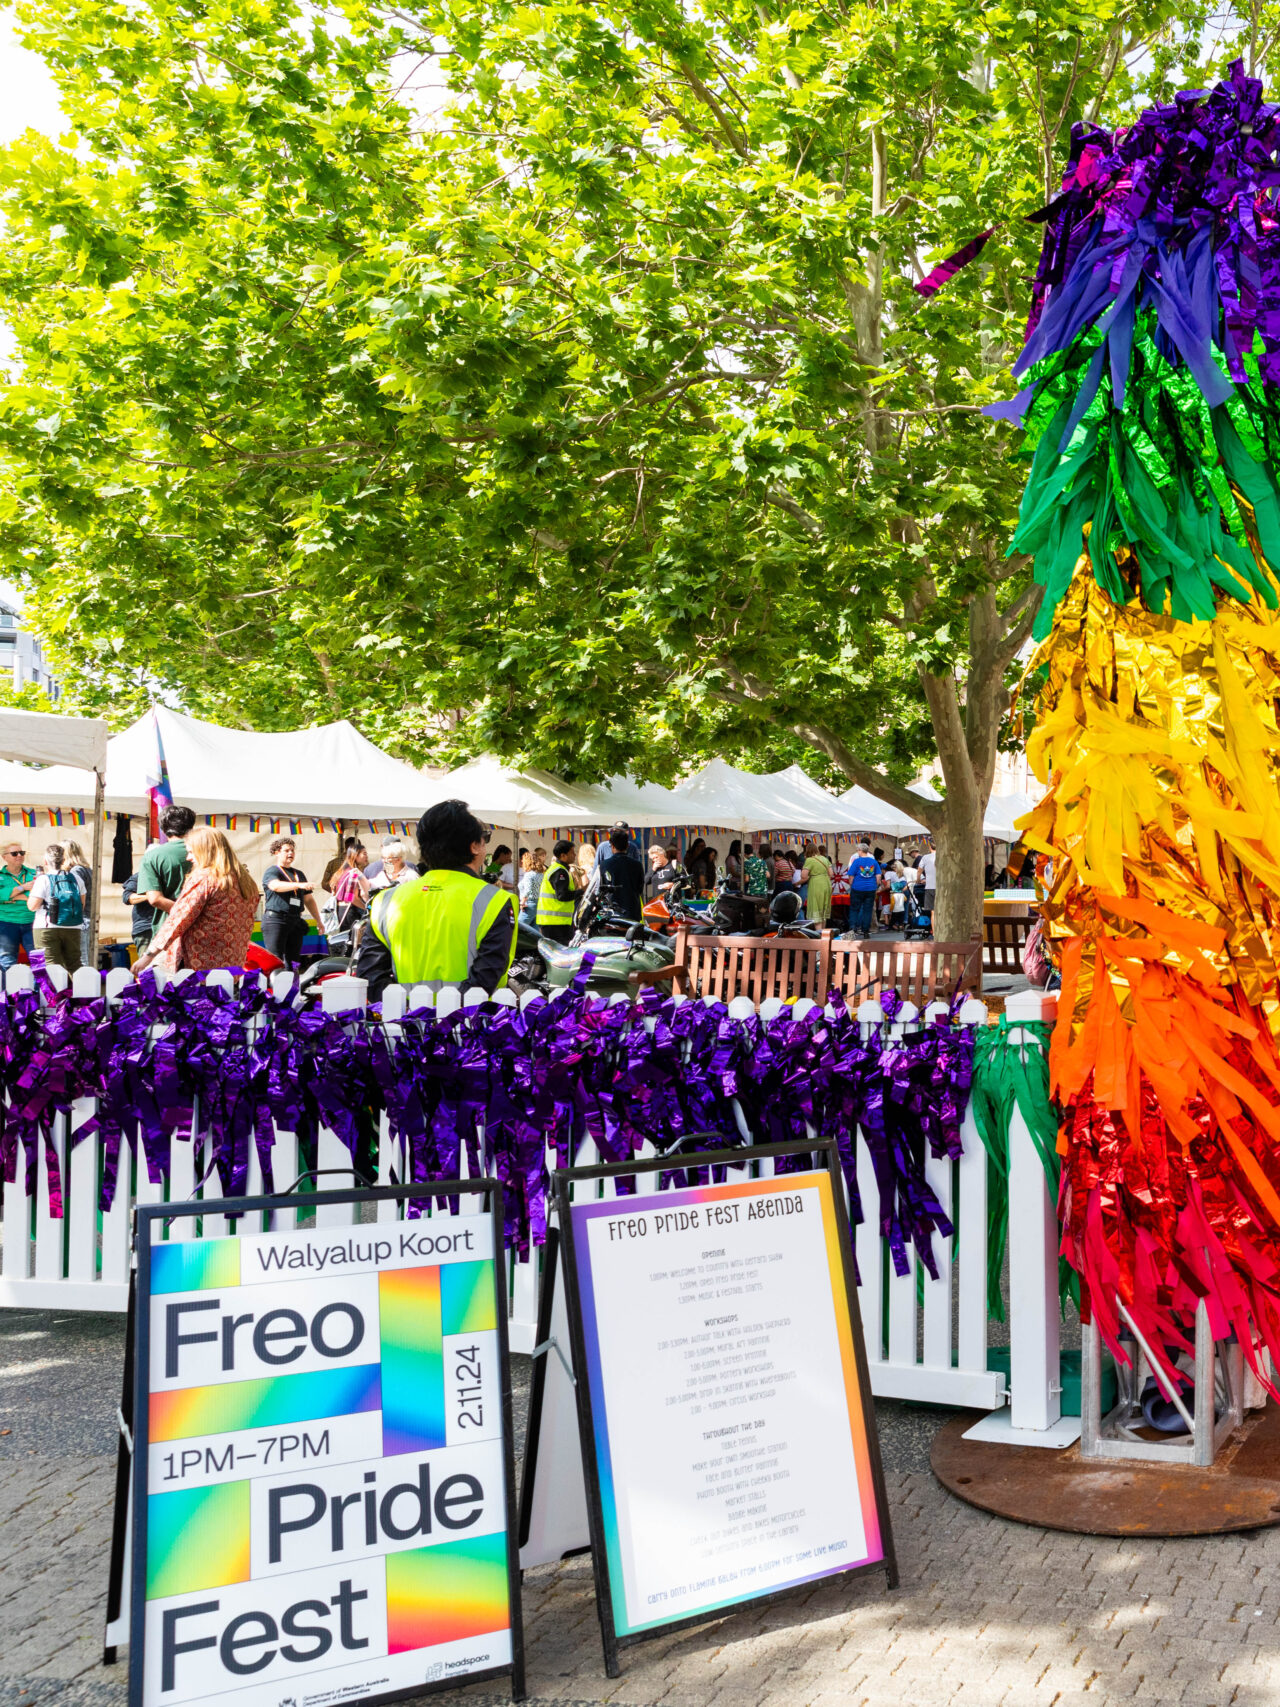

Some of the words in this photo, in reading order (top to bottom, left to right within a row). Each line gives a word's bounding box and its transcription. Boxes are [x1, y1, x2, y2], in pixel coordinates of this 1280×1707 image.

[258, 1239, 392, 1271] Walyalup
[399, 1230, 474, 1257] Koort
[165, 1299, 366, 1379] Freo
[456, 1344, 483, 1429] 2.11.24
[268, 1463, 484, 1563] Pride
[162, 1579, 369, 1692] Fest
[445, 1654, 490, 1669] headspace
